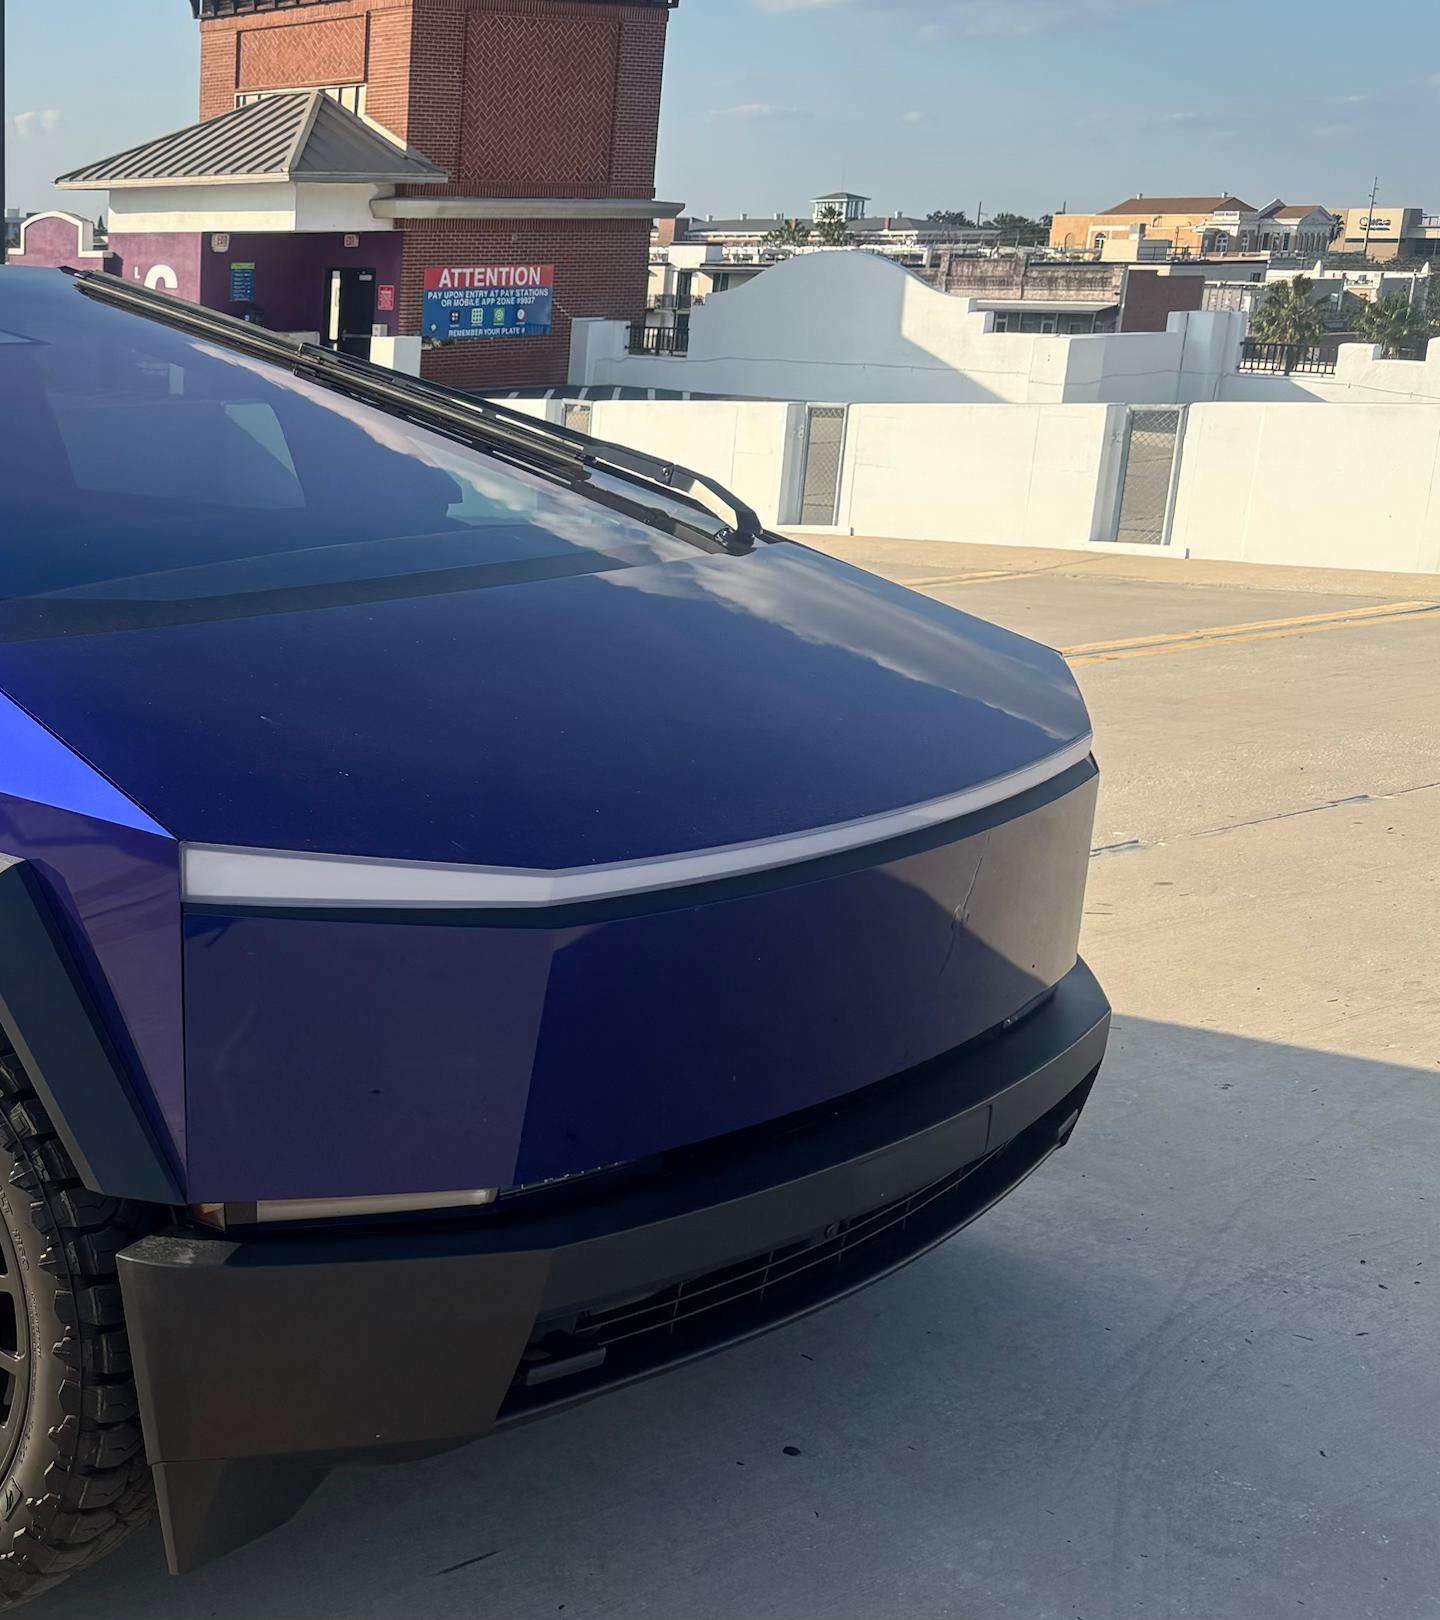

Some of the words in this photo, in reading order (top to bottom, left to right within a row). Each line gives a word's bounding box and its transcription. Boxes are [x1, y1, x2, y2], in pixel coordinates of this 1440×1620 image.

[439, 266, 541, 288] ATTENTION
[428, 291, 442, 300] PAY
[444, 290, 464, 299] UPON
[465, 290, 488, 298] ENTRY
[489, 289, 499, 298] AT
[500, 289, 514, 298] PAY
[516, 288, 548, 297] STATIONS
[441, 298, 452, 306] OR
[453, 298, 480, 306] MOBILE
[481, 297, 496, 306] APP
[496, 296, 515, 306] ZONE
[448, 328, 483, 338] REMEMBER
[484, 328, 500, 336] YOUR
[501, 326, 520, 336] PLATE
